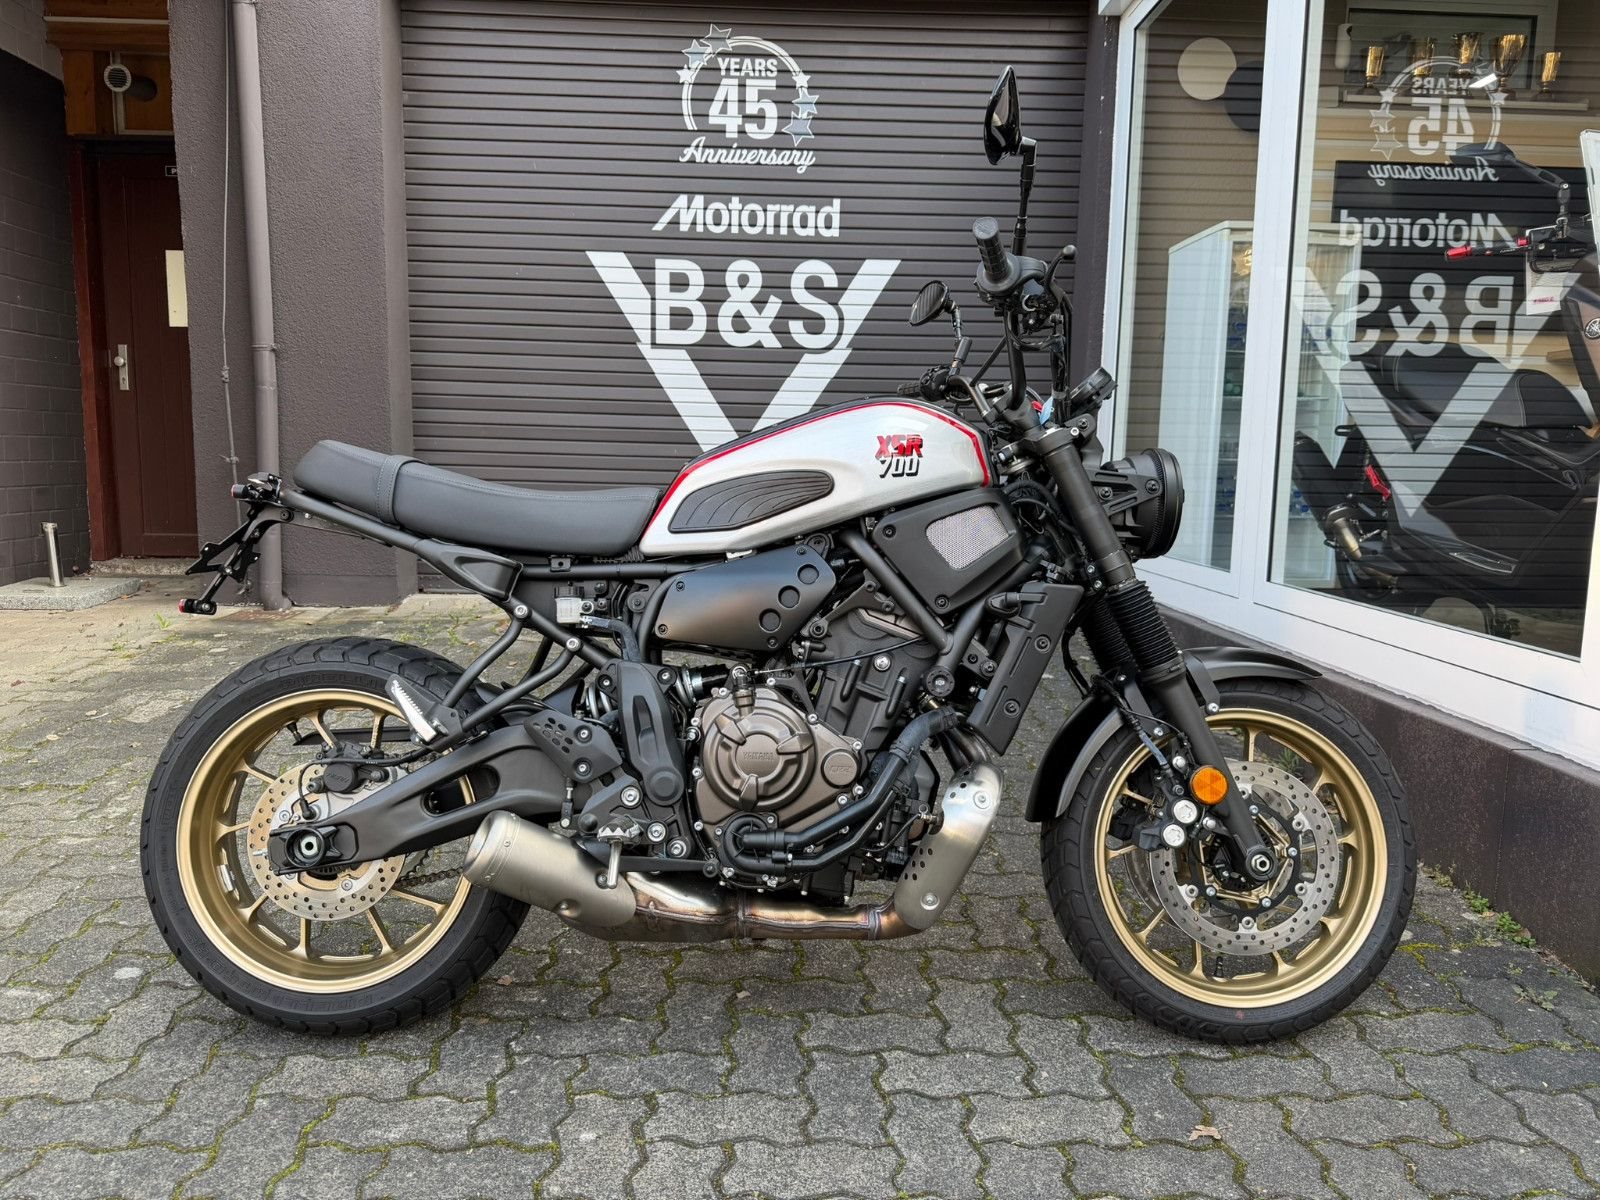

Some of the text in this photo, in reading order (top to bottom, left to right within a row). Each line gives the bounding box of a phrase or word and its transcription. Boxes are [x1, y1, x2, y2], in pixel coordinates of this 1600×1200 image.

[717, 57, 778, 77] YEARS
[708, 78, 778, 139] 45
[679, 136, 816, 174] Anniversary
[651, 194, 841, 237] Motorrad
[655, 258, 839, 349] B&S
[875, 434, 923, 460] XSR
[879, 454, 920, 478] 700
